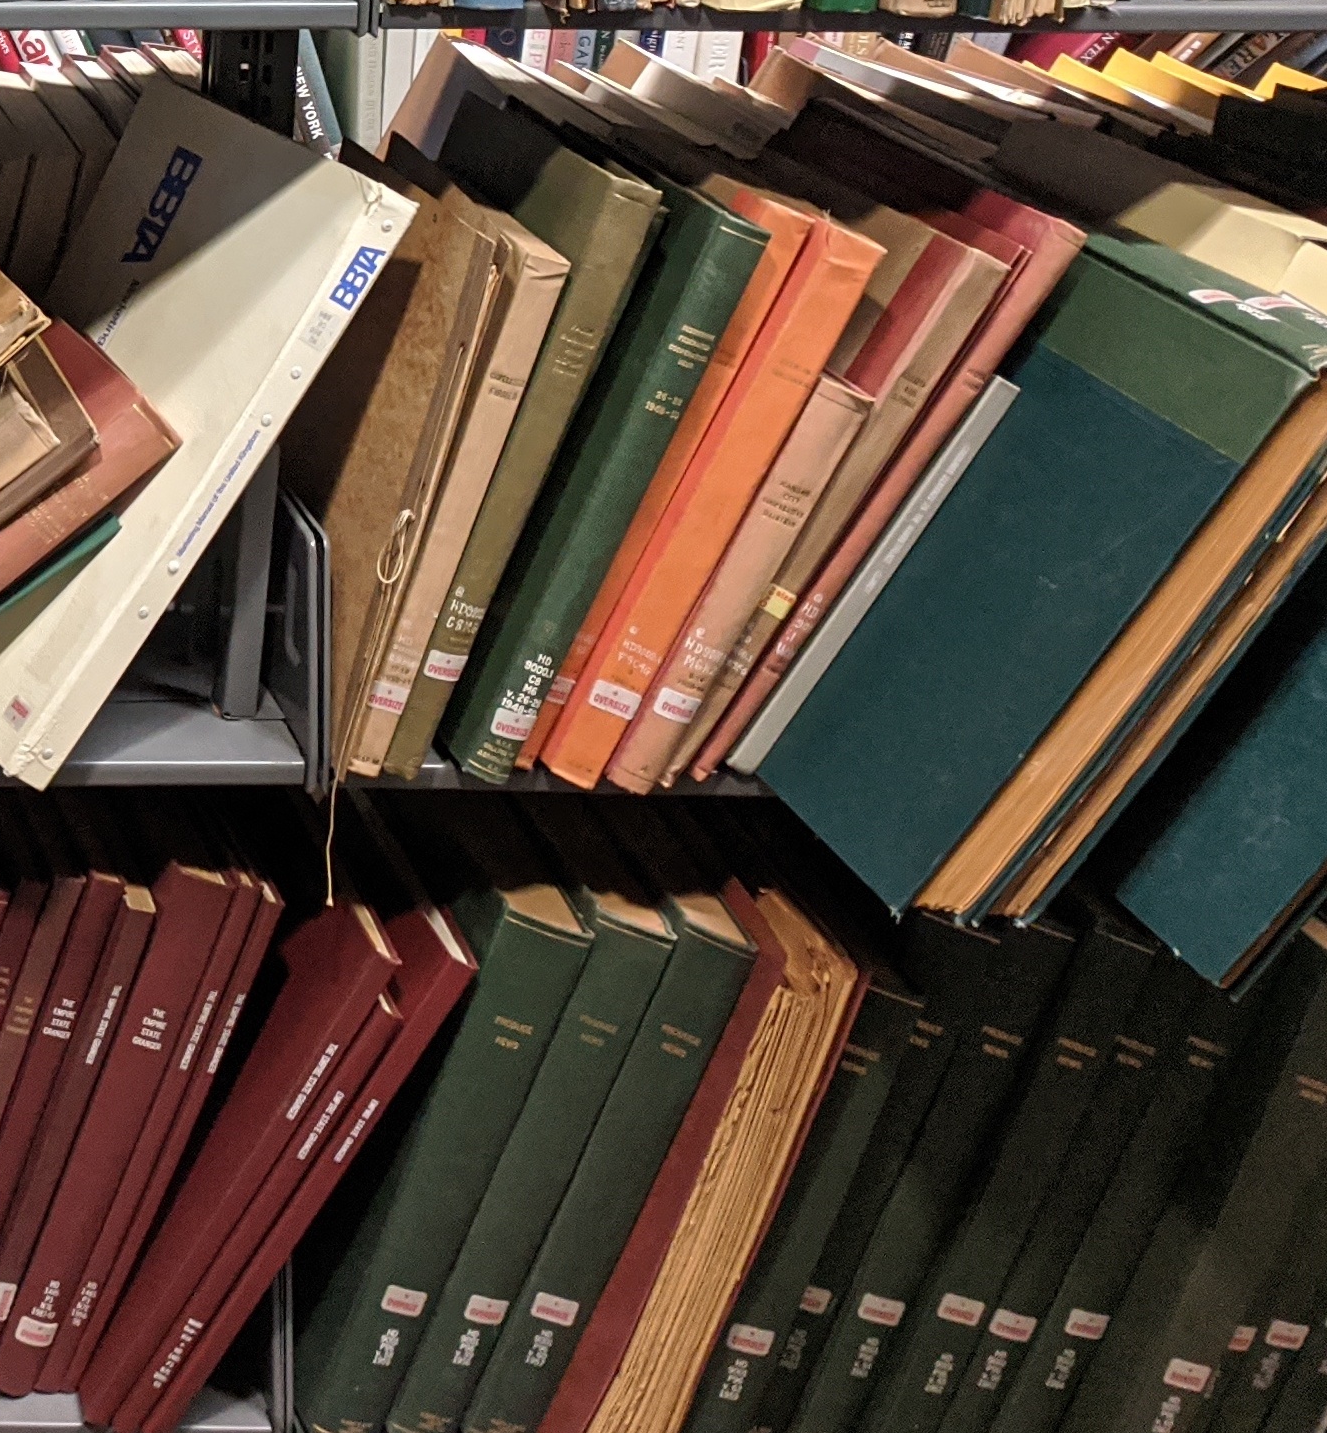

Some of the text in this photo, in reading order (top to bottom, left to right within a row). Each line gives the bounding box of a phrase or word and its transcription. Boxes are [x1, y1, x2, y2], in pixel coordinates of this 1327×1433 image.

[295, 65, 325, 140] NEW YORK
[537, 653, 552, 666] HD
